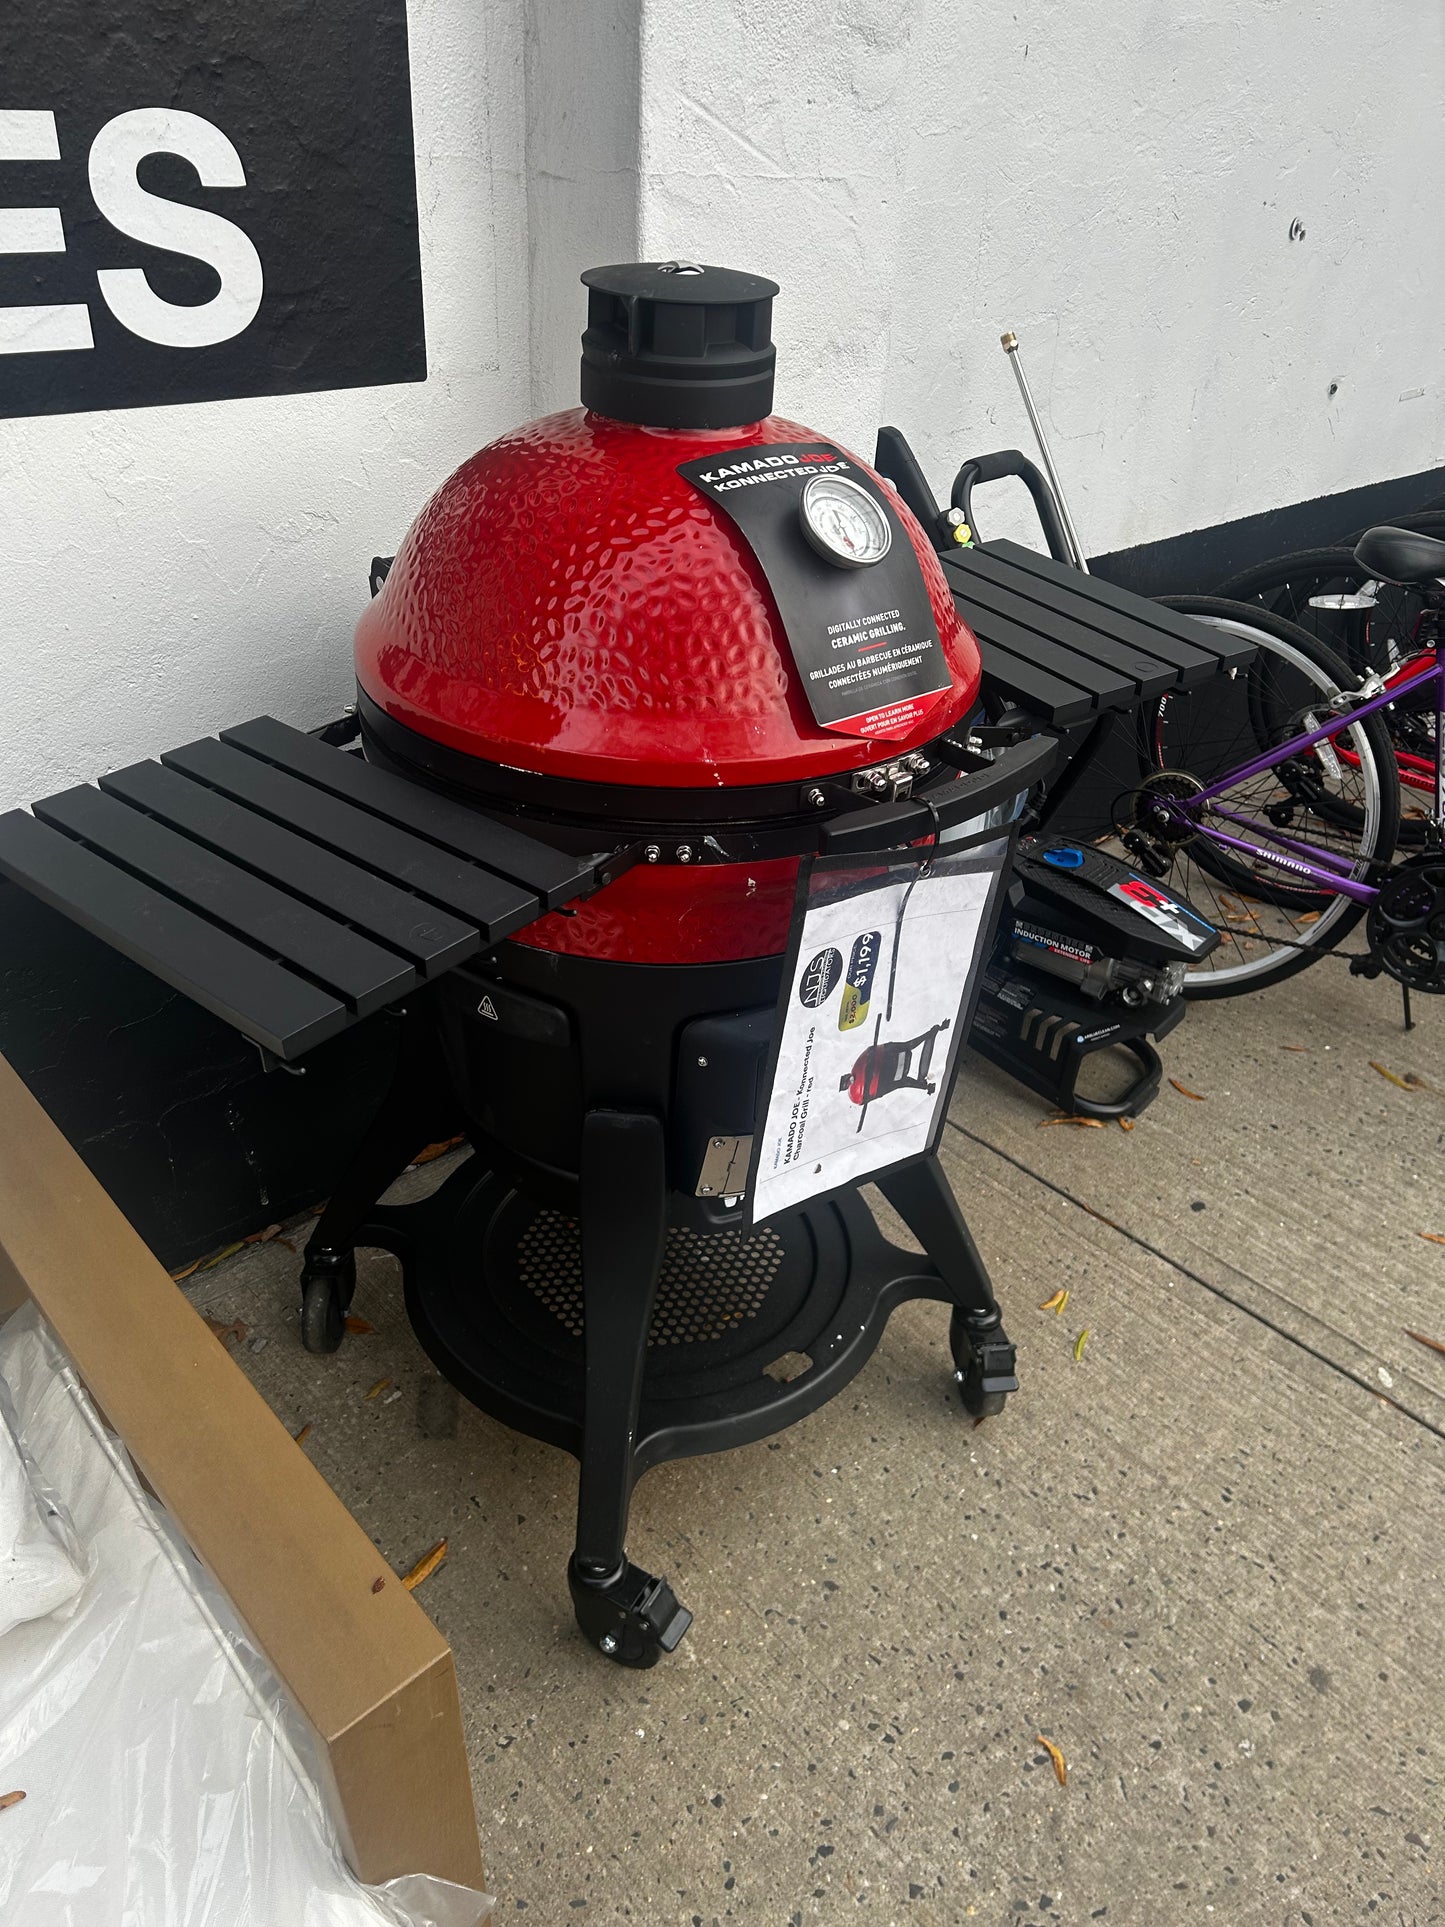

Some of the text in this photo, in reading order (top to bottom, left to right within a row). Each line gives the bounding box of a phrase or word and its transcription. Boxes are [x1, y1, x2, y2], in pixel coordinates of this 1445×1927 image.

[827, 609, 900, 635] DIGITALLY CONNECTED
[831, 621, 906, 649] CERAMIC GRILLING.
[809, 639, 933, 681] GRILLADES AU BARBECUE EN CÉRAMIQUE
[828, 671, 872, 689] CONNECTÉES
[872, 655, 923, 677] NUMÉRIQUEMENT
[865, 703, 914, 724] OPEN TO LEARN MORE
[913, 708, 924, 718] PLUS
[1157, 696, 1167, 717] 700
[1255, 848, 1312, 875] SHIMANO
[1014, 927, 1091, 959] INDUCTION MOTOR
[853, 933, 874, 988] $1,199
[803, 956, 824, 1006] NJS
[784, 1121, 797, 1165] KAMADO
[791, 1102, 800, 1120] JOE
[796, 1045, 812, 1095] Konnected
[806, 1026, 816, 1043] Joe
[793, 1120, 806, 1161] Charcoal
[800, 1099, 810, 1119] Grill
[806, 1076, 815, 1092] red
